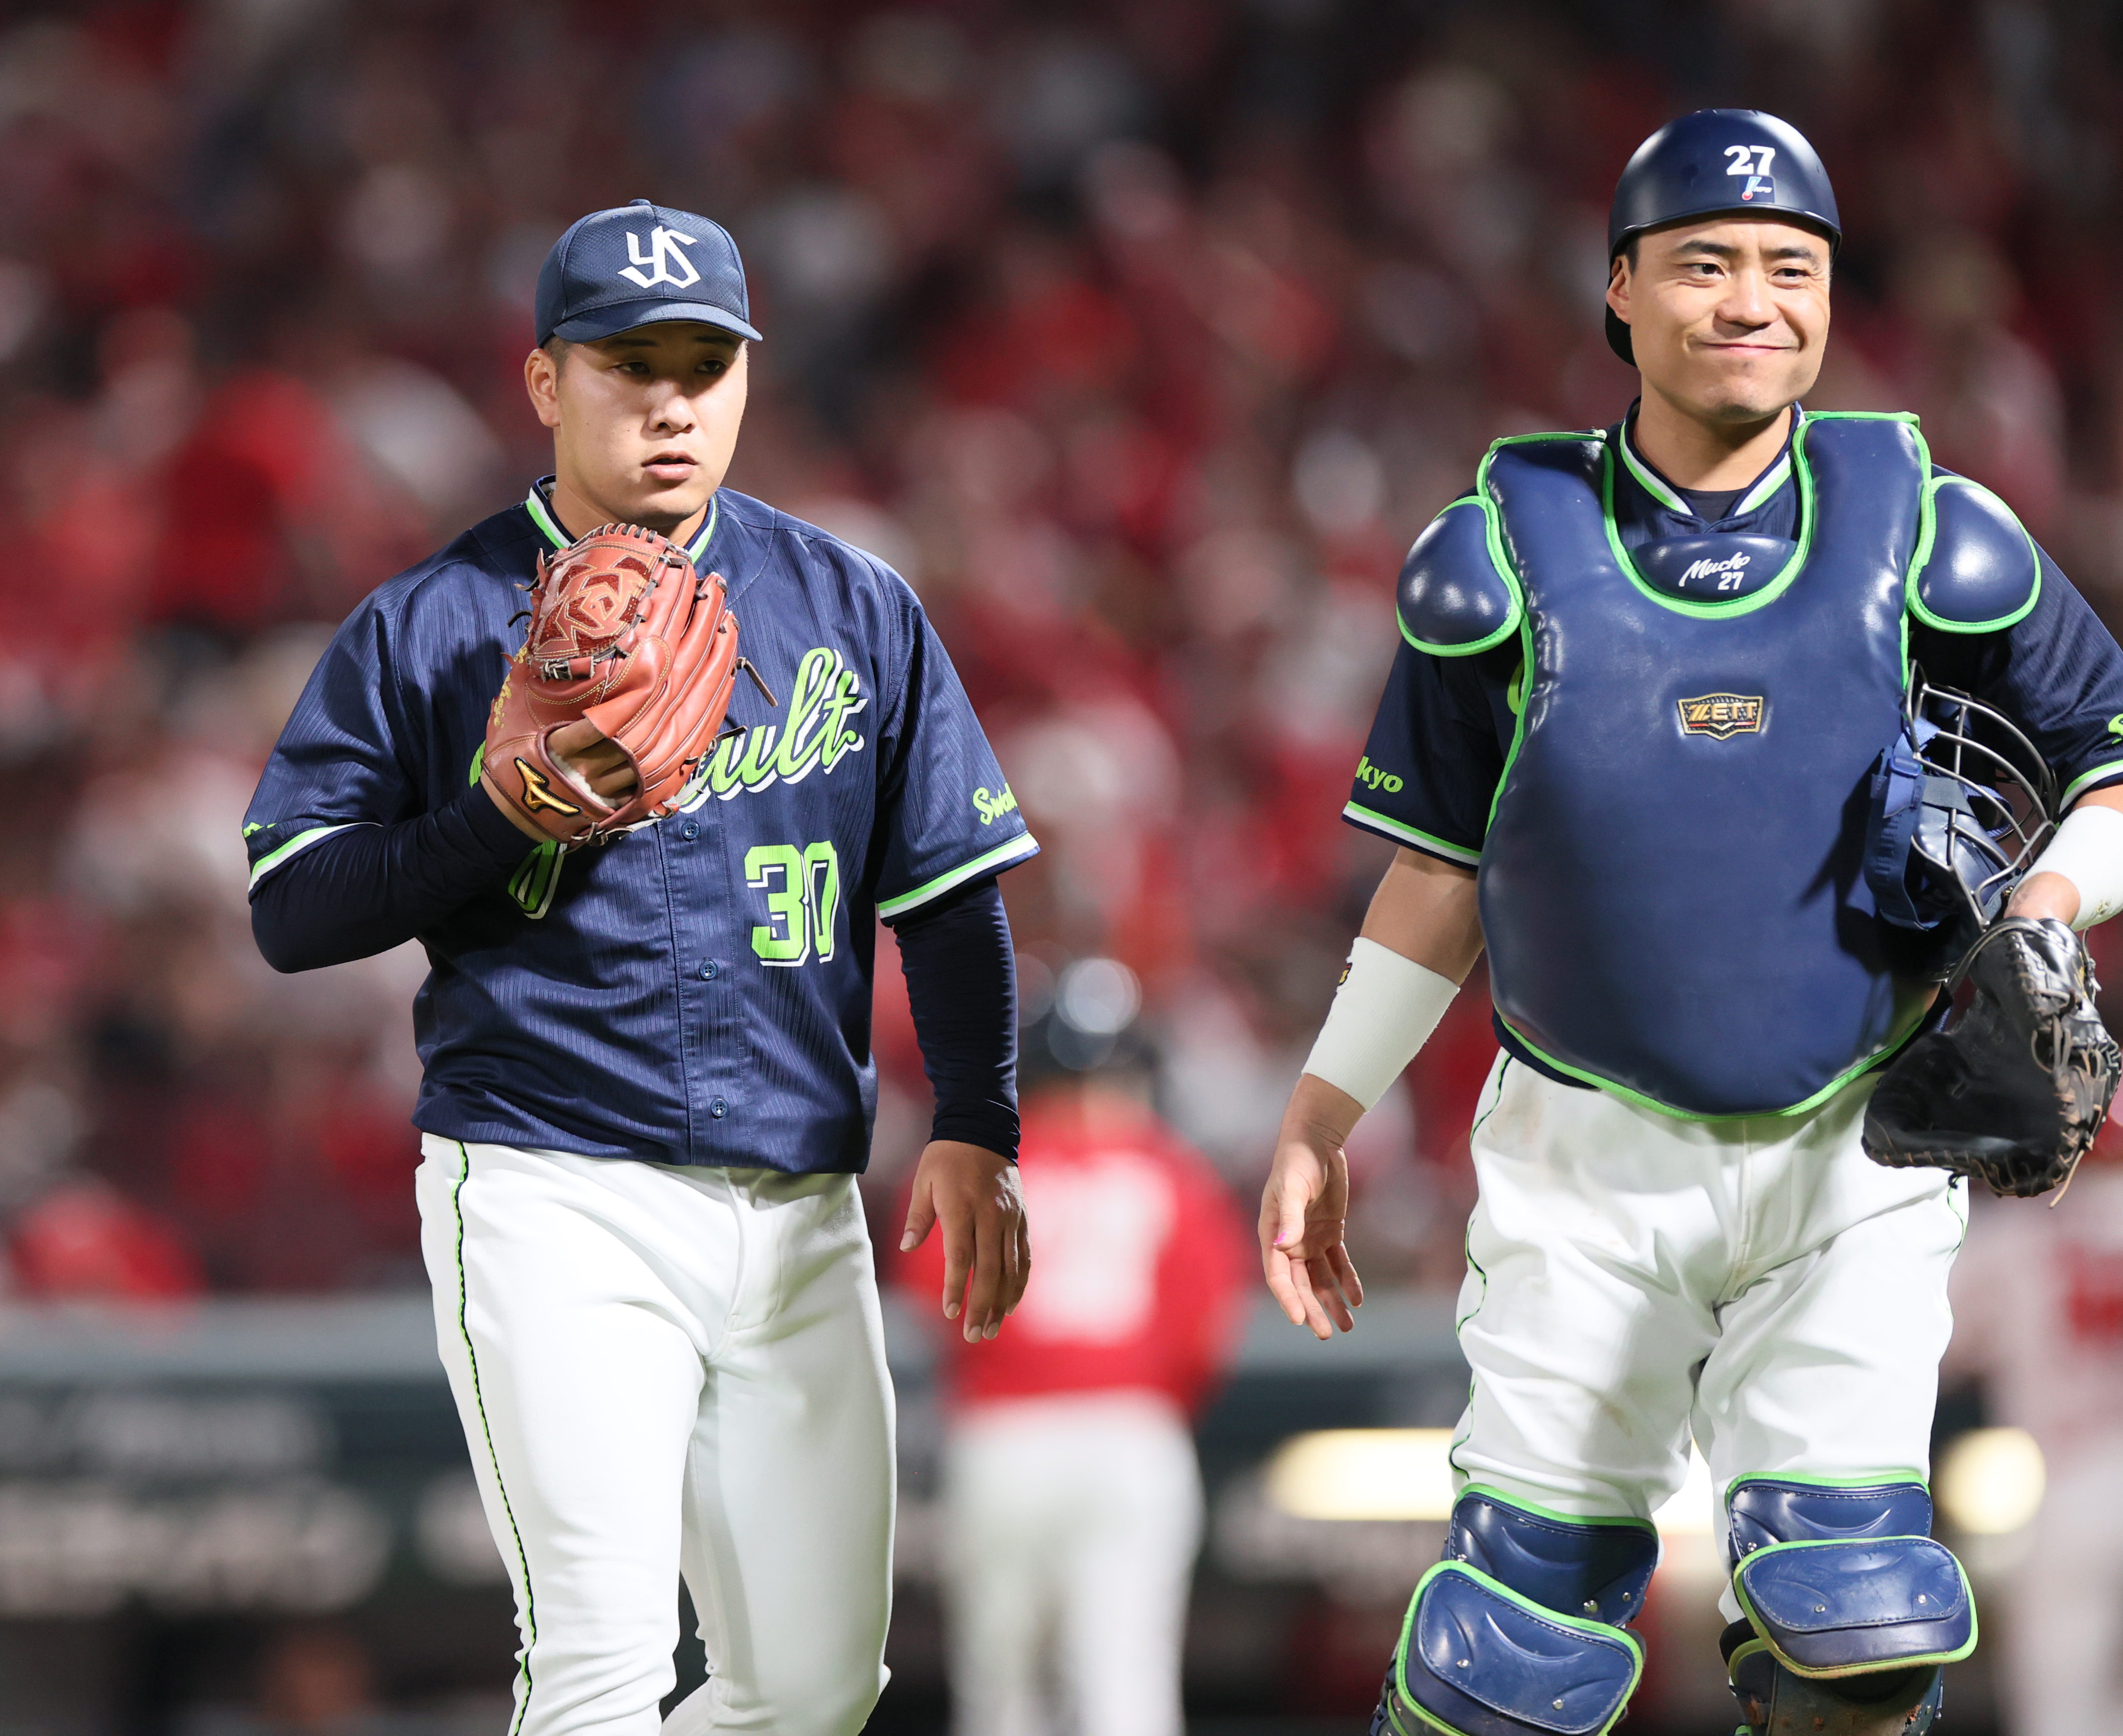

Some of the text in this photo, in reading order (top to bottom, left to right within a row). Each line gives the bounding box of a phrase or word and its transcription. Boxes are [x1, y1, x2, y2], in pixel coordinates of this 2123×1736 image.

[1724, 145, 1775, 176] 27
[1678, 551, 1750, 587] Mucho
[1717, 572, 1744, 590] 27
[1688, 702, 1757, 721] ZETT
[1355, 755, 1404, 793] kyo
[744, 840, 840, 966] 30
